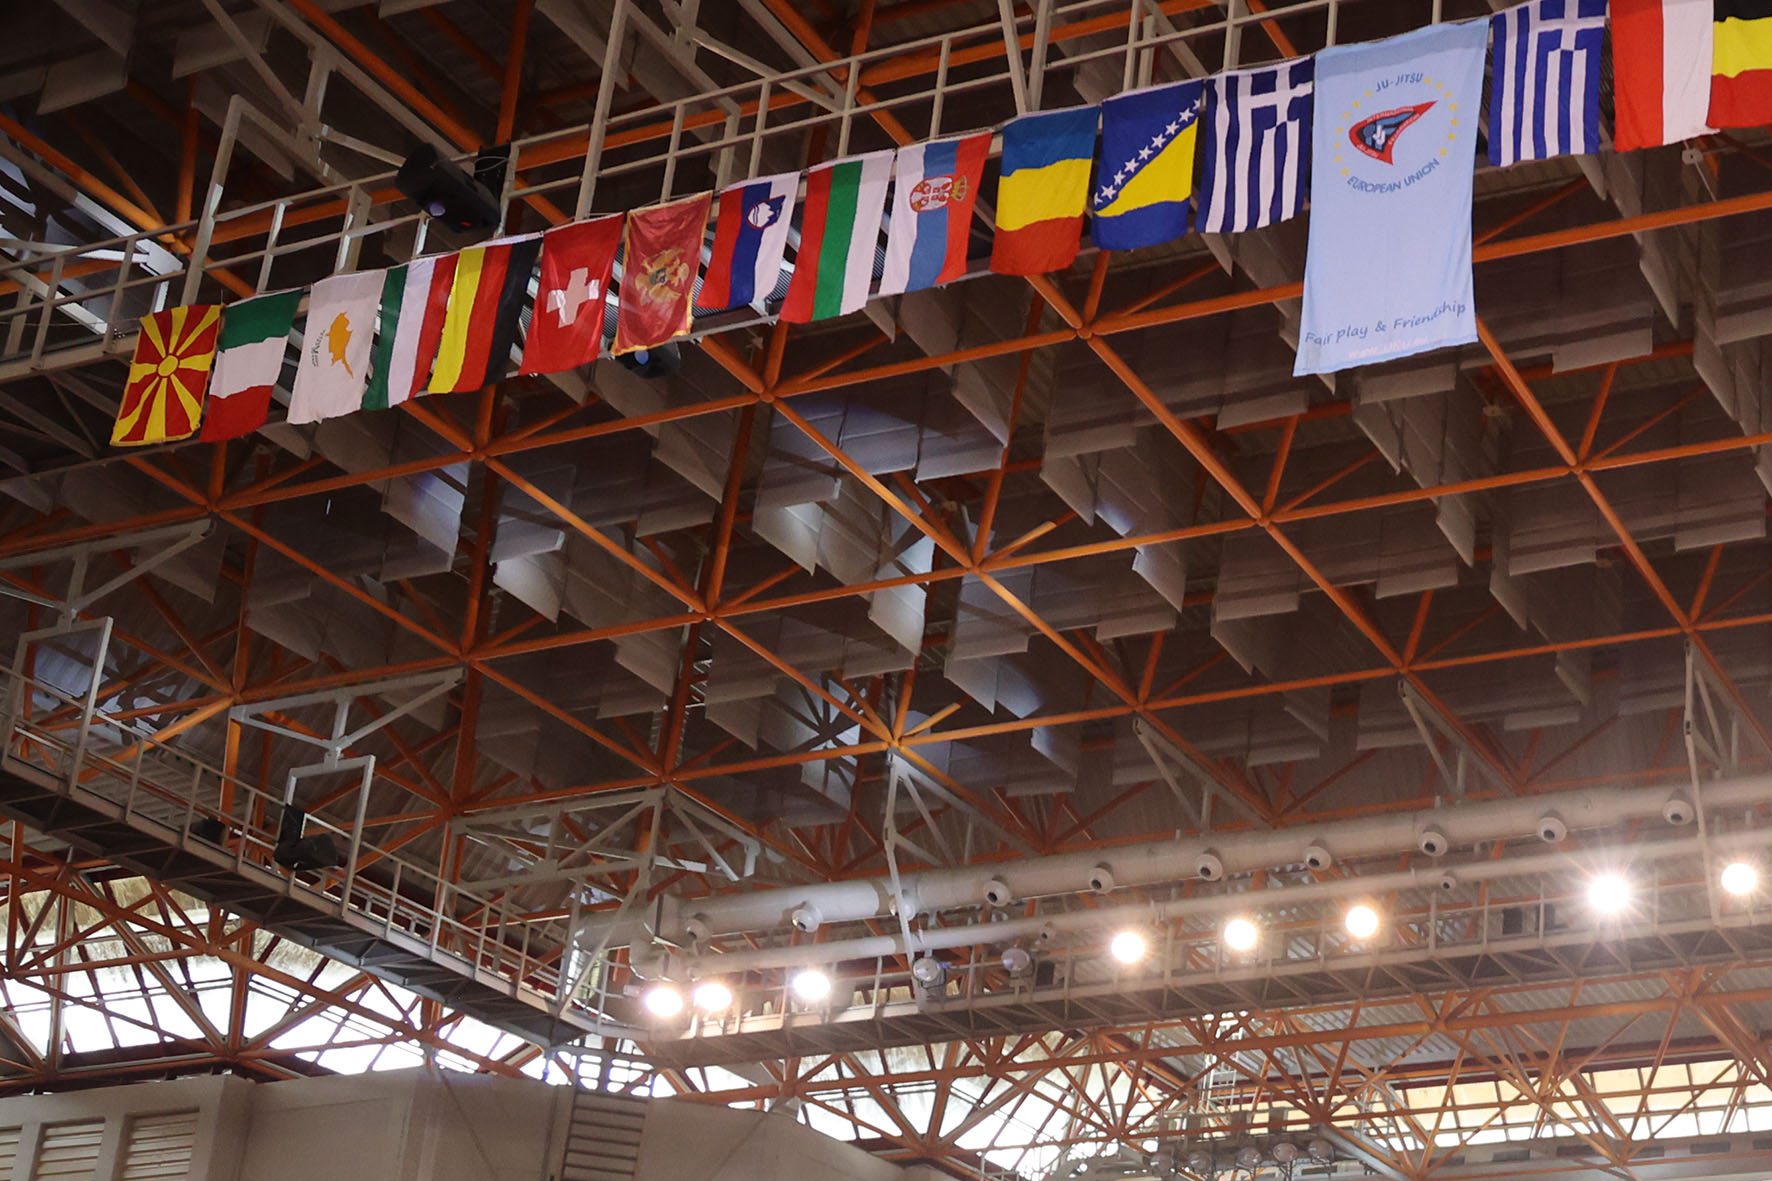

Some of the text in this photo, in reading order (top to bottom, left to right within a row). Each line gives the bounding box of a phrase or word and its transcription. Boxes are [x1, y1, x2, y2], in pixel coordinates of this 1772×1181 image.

[1376, 72, 1424, 92] JU-JITSU
[1346, 157, 1440, 194] EUROPEAN UNION
[1304, 331, 1333, 346] Fair
[1374, 320, 1387, 333] &
[1393, 300, 1467, 330] Friendship
